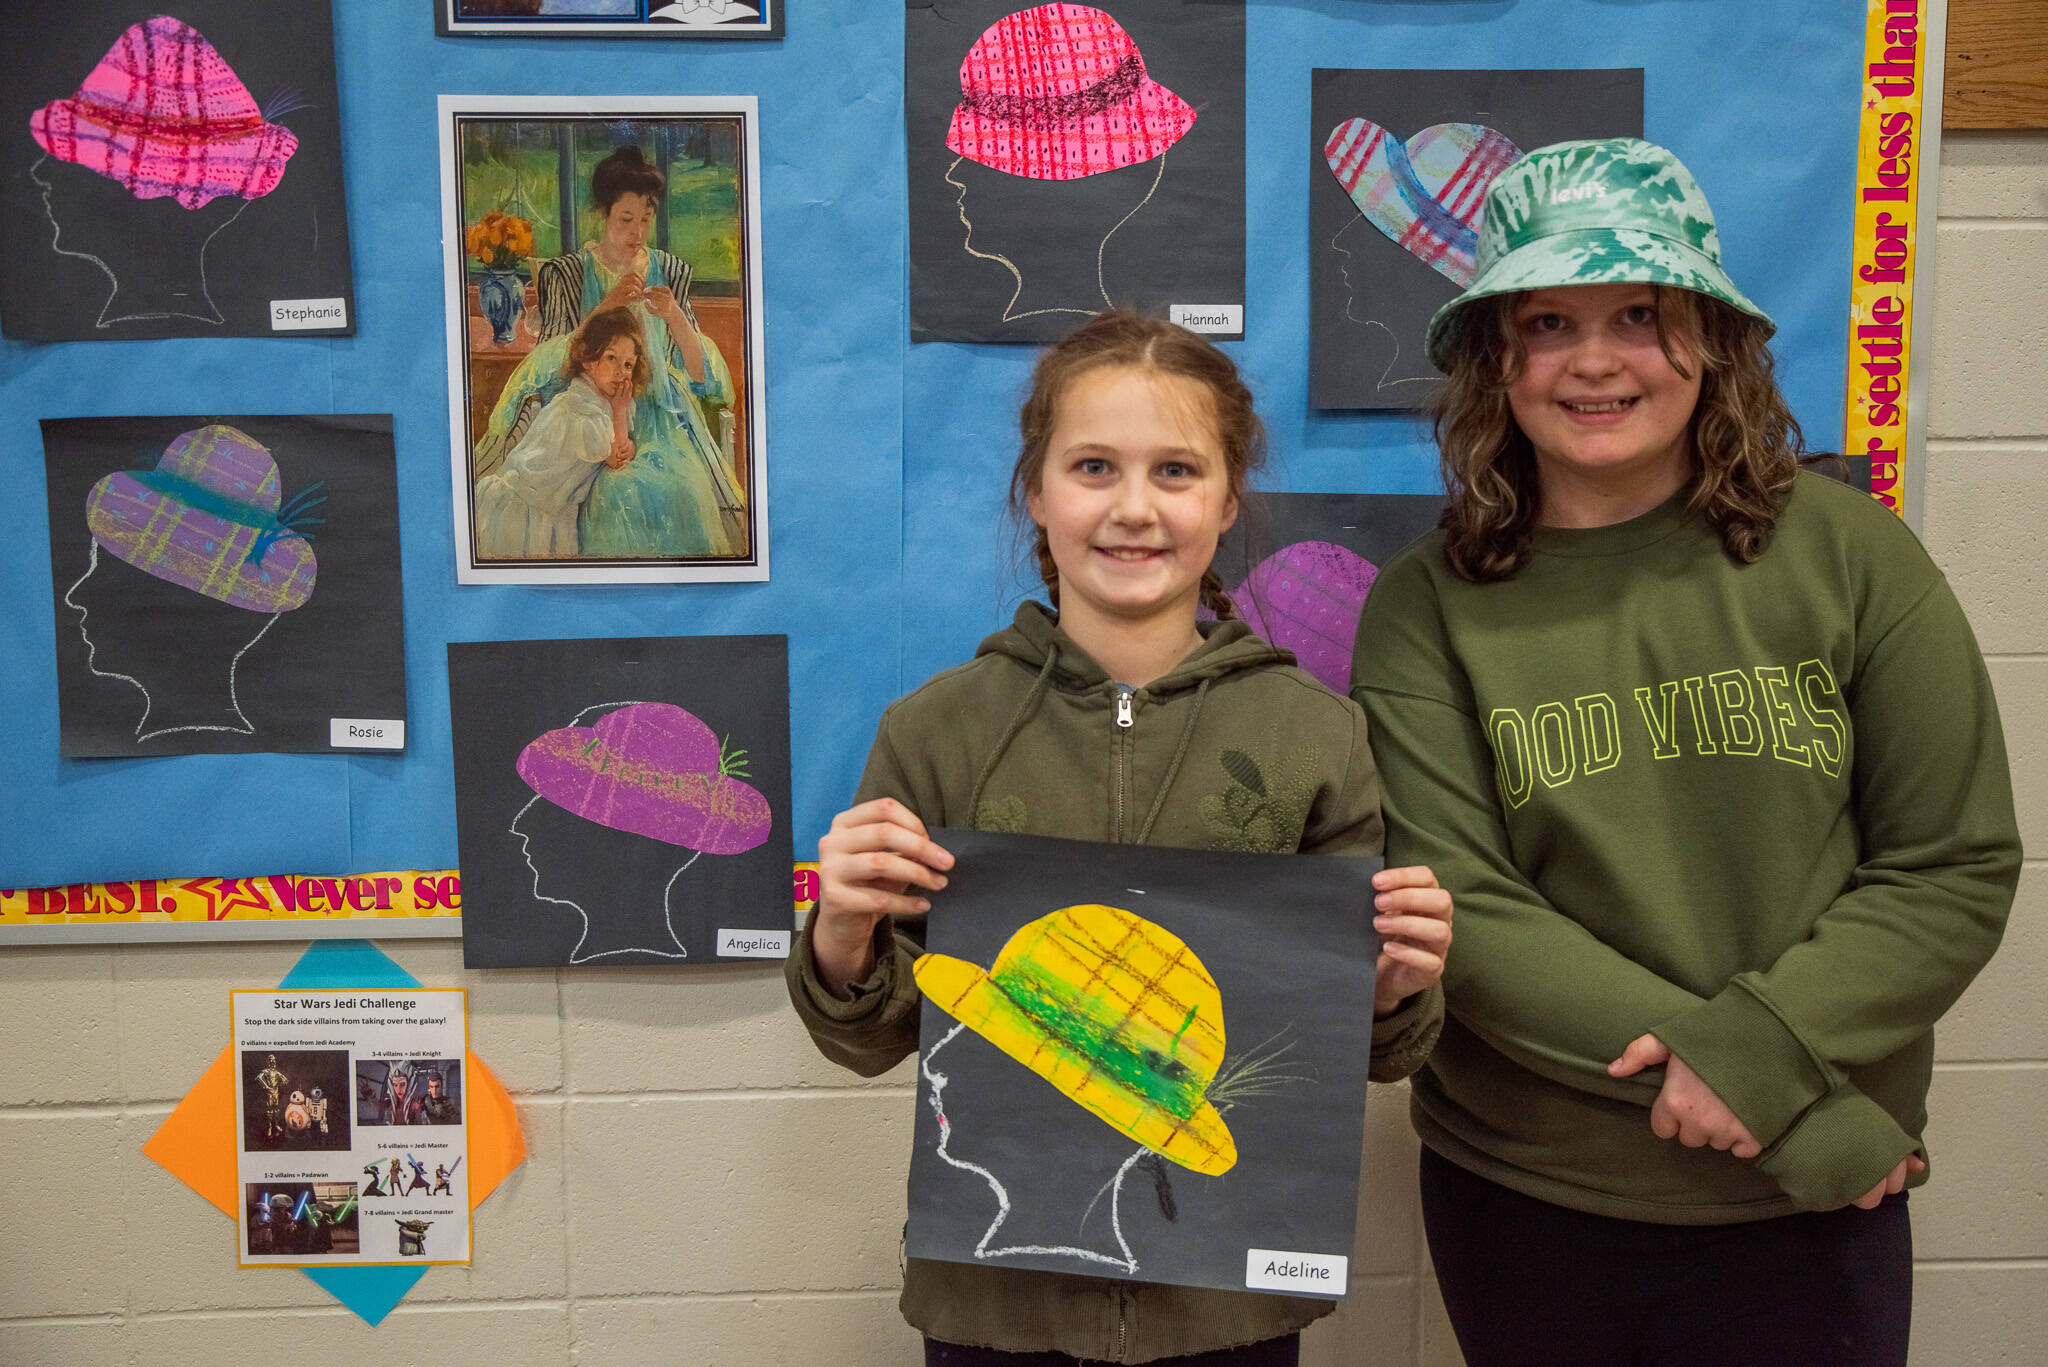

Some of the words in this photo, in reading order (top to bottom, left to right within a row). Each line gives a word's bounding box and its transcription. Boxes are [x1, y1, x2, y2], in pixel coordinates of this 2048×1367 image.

[1862, 111, 1914, 204] less
[1858, 211, 1908, 285] for
[275, 305, 342, 322] Stephanie
[1182, 312, 1229, 326] Hannah
[1857, 295, 1905, 427] settle
[349, 725, 384, 738] Rosie
[1488, 692, 1622, 809] OOD
[1634, 658, 1846, 778] VIBES
[267, 874, 403, 912] Never
[726, 938, 781, 953] Angelica
[274, 998, 298, 1009] Star
[300, 998, 331, 1009] Wars
[333, 998, 357, 1009] Jedi
[359, 998, 417, 1011] Challenge
[244, 1018, 262, 1026] Stop
[313, 1017, 341, 1025] villains
[341, 1017, 360, 1025] from
[361, 1017, 385, 1026] taking
[405, 1017, 418, 1025] the
[419, 1017, 447, 1026] galaxy!
[328, 1039, 356, 1047] Academy
[422, 1050, 442, 1058] Knight
[1264, 1260, 1331, 1280] Adeline
